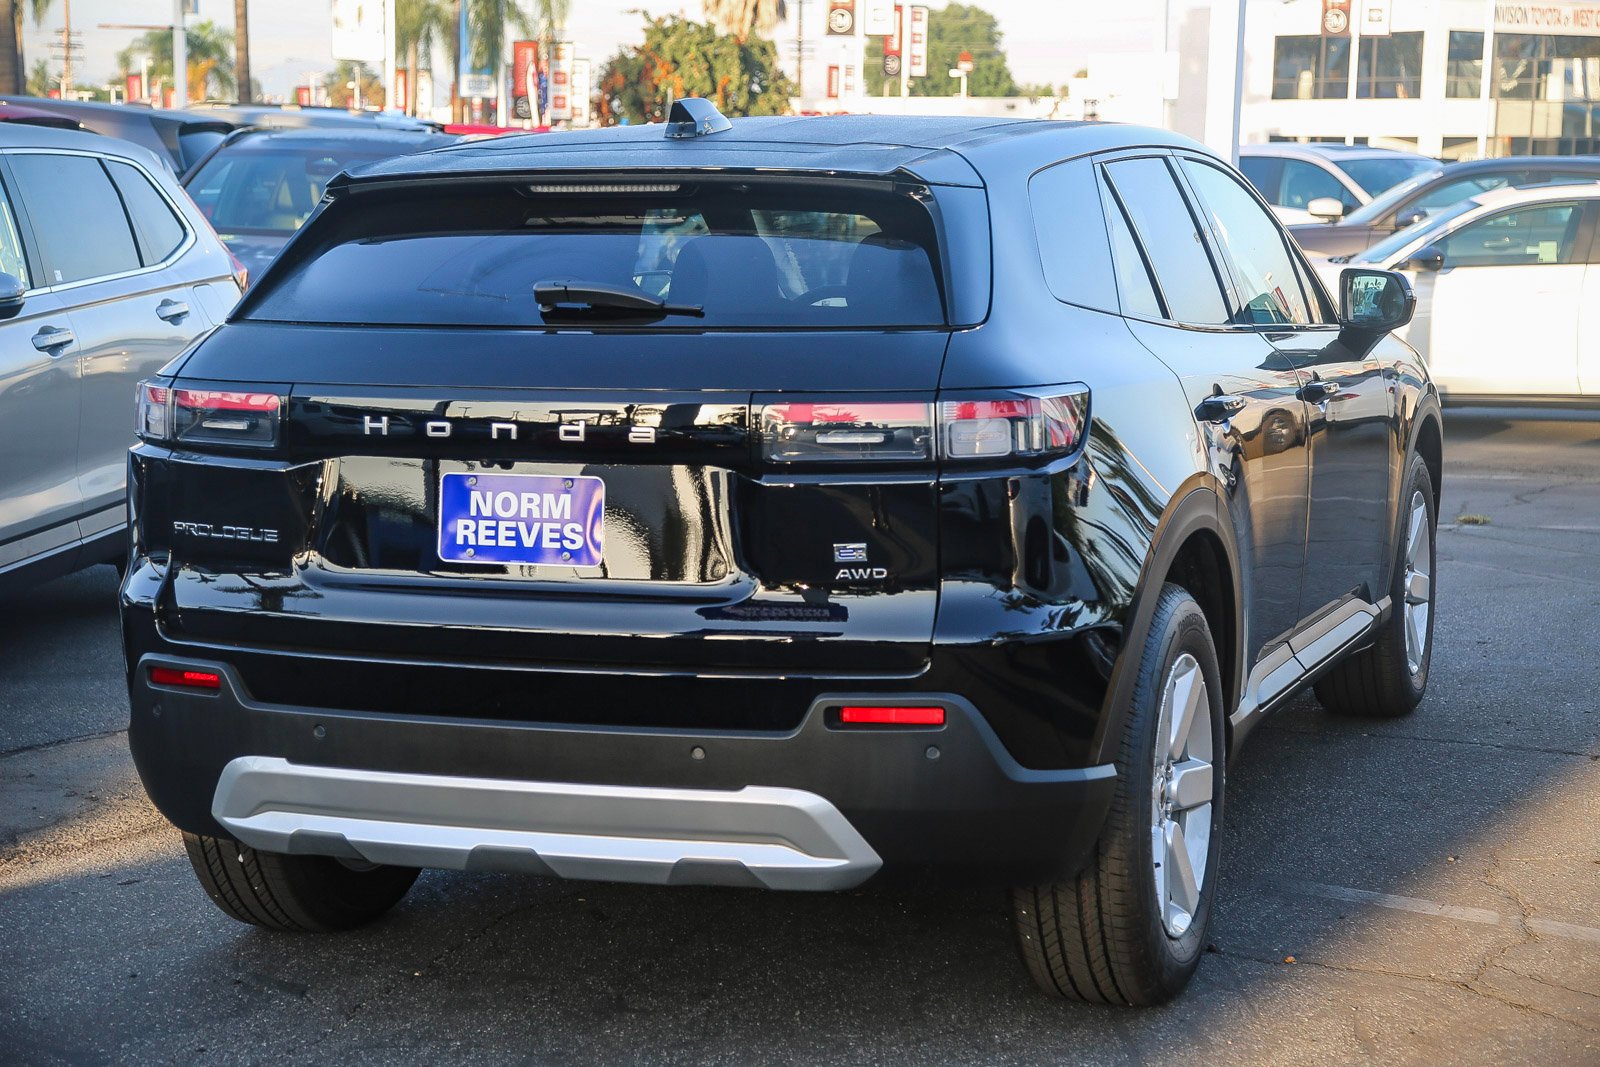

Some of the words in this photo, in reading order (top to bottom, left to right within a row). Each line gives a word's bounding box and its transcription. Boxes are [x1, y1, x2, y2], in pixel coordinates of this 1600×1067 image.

[1494, 6, 1528, 25] NVISION
[470, 490, 572, 520] NORM
[173, 521, 278, 542] PROLOGUE
[456, 519, 584, 550] REEVES
[835, 567, 888, 580] AWD
